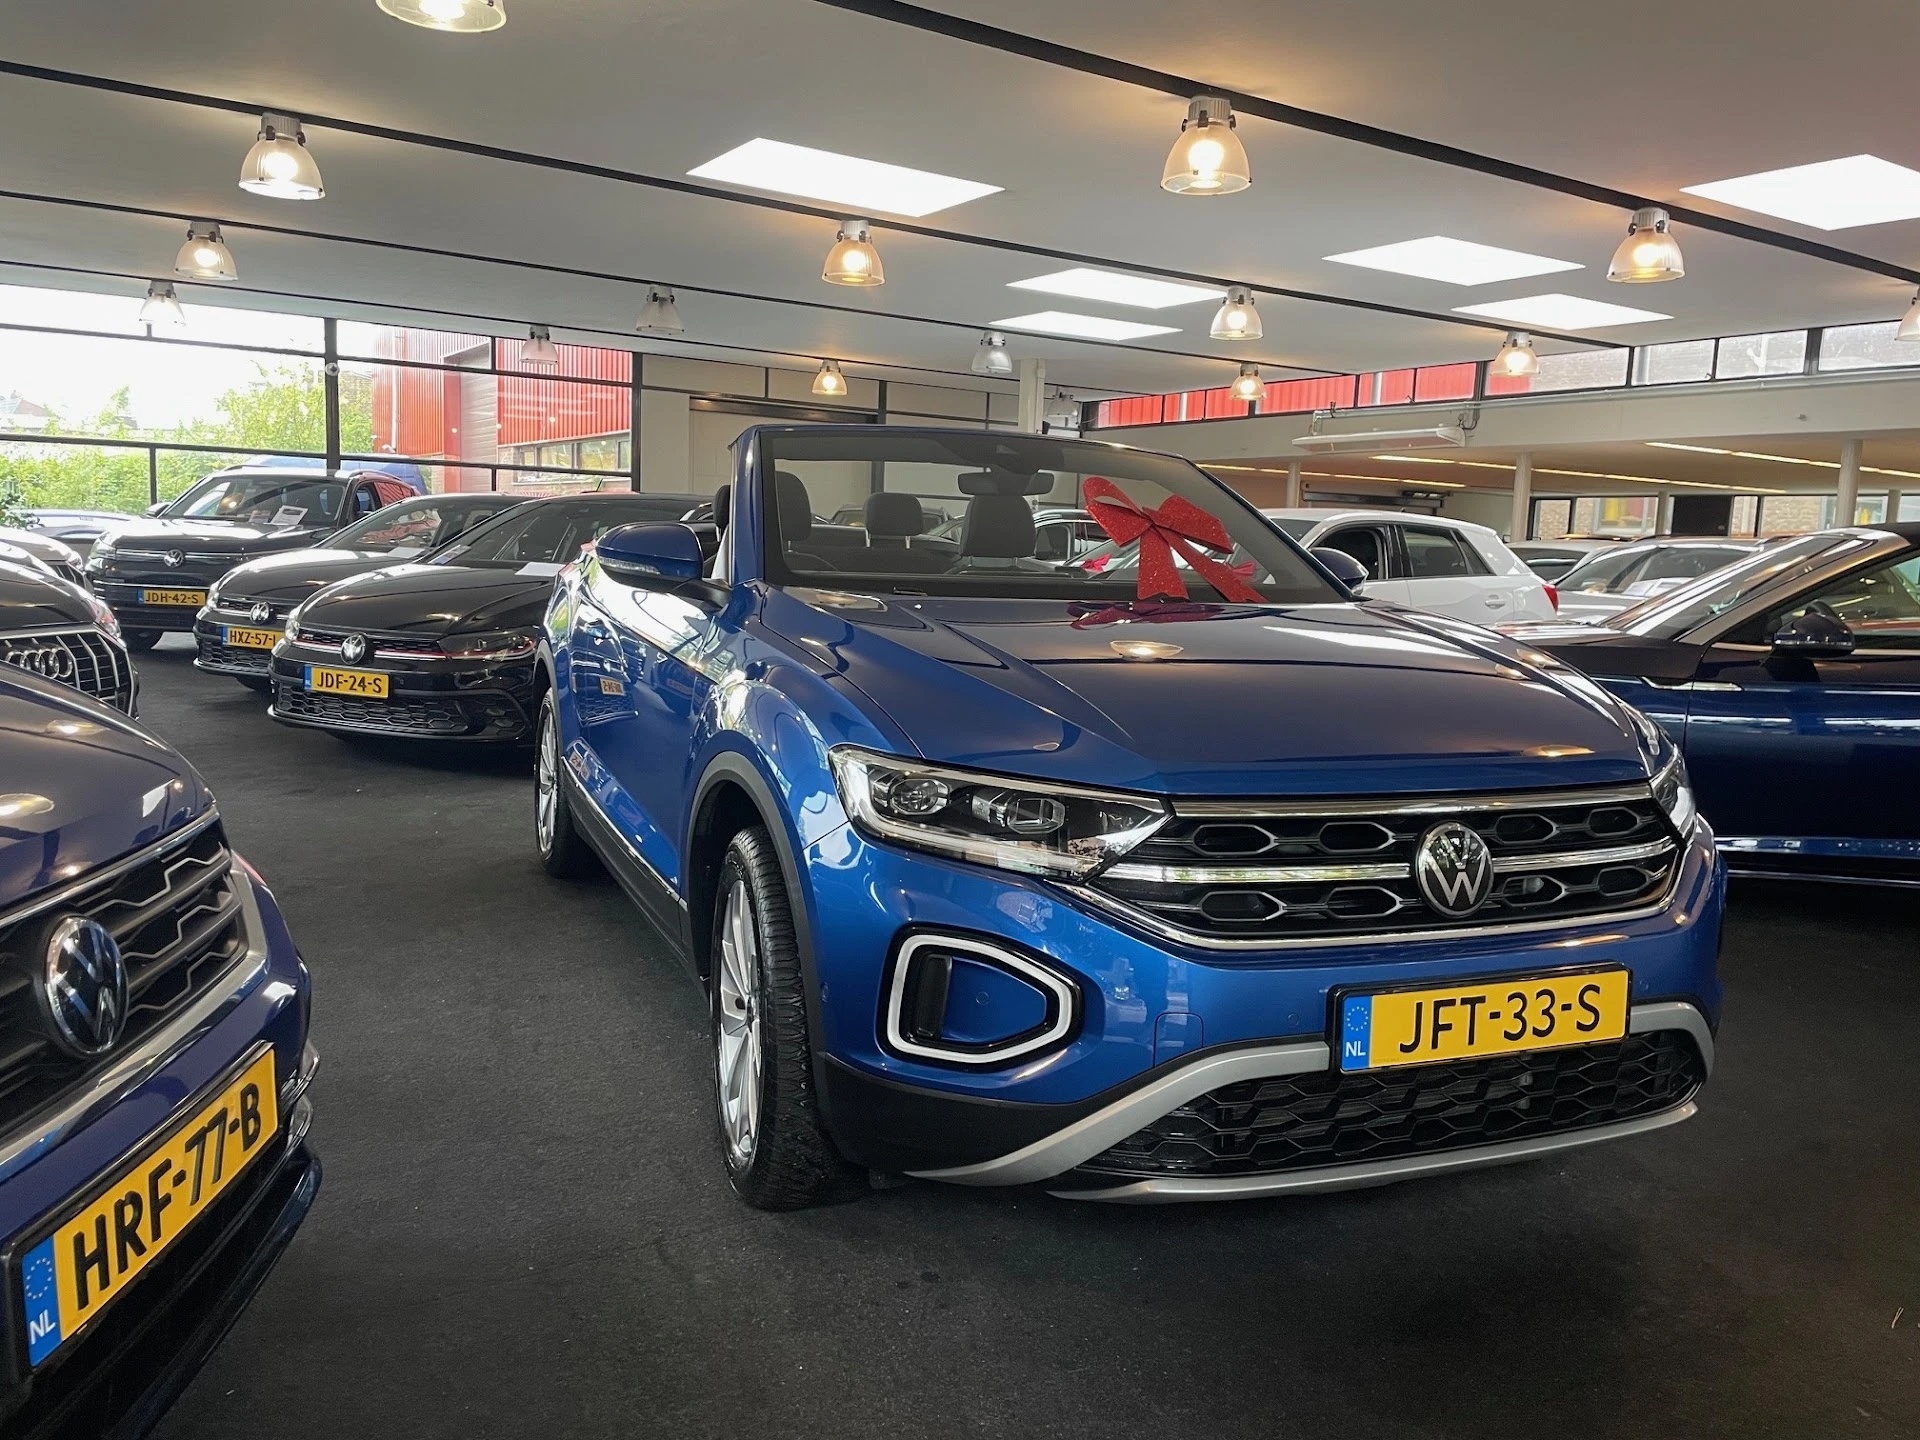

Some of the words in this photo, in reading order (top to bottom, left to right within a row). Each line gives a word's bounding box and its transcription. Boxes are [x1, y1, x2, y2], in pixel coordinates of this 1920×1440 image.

[145, 591, 199, 604] JDH-42-S
[317, 671, 382, 694] JDF-24-S
[1400, 983, 1600, 1054] JFT-33-S
[1345, 1040, 1367, 1058] NL
[72, 1083, 262, 1312] HRF-77-B
[29, 1308, 57, 1345] NL
